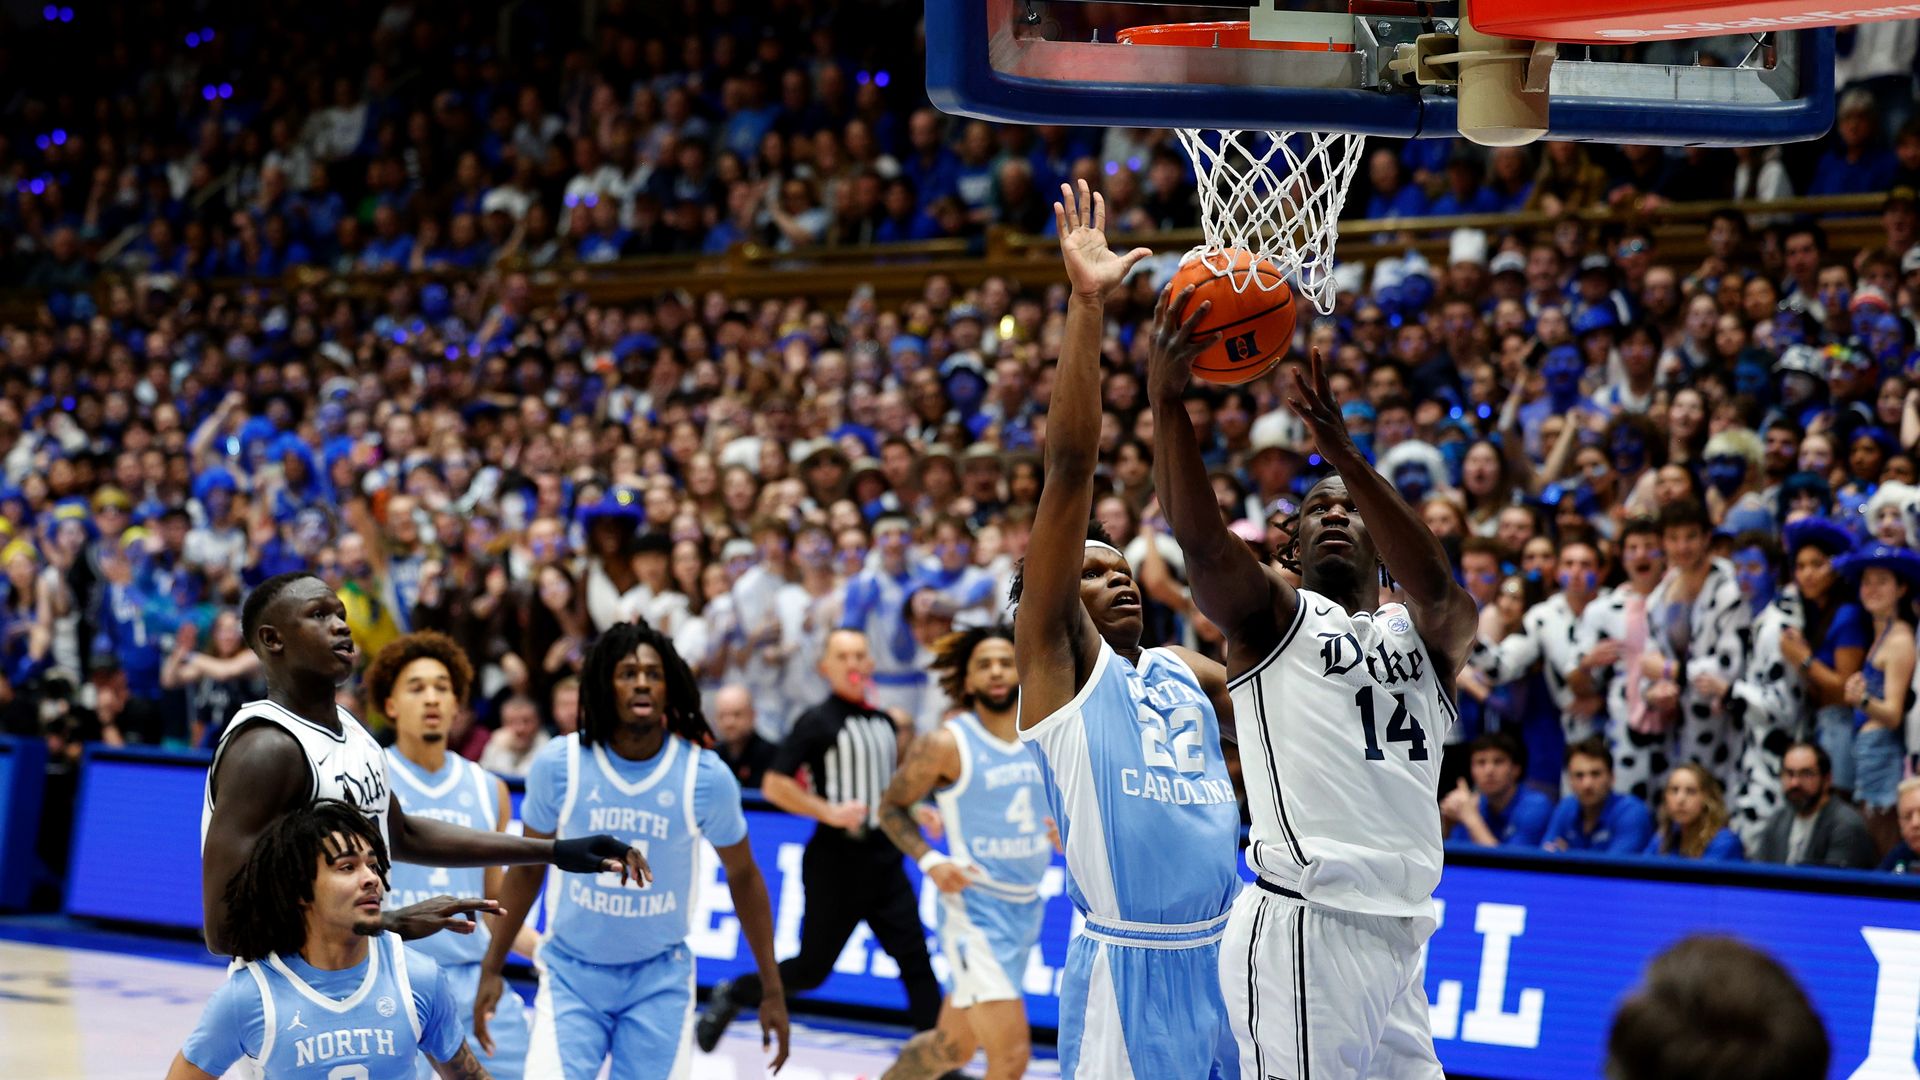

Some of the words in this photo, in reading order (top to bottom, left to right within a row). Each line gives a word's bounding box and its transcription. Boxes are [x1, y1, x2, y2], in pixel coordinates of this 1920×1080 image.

[1126, 676, 1203, 711] NRTH
[1137, 702, 1205, 774] 22
[1355, 685, 1428, 761] 14
[334, 762, 386, 809] Duk
[1121, 767, 1238, 806] CAROLINA
[587, 806, 669, 839] NORTH
[1004, 786, 1037, 834] 4
[569, 878, 677, 918] CAROLINA
[294, 1028, 396, 1067] NORTH
